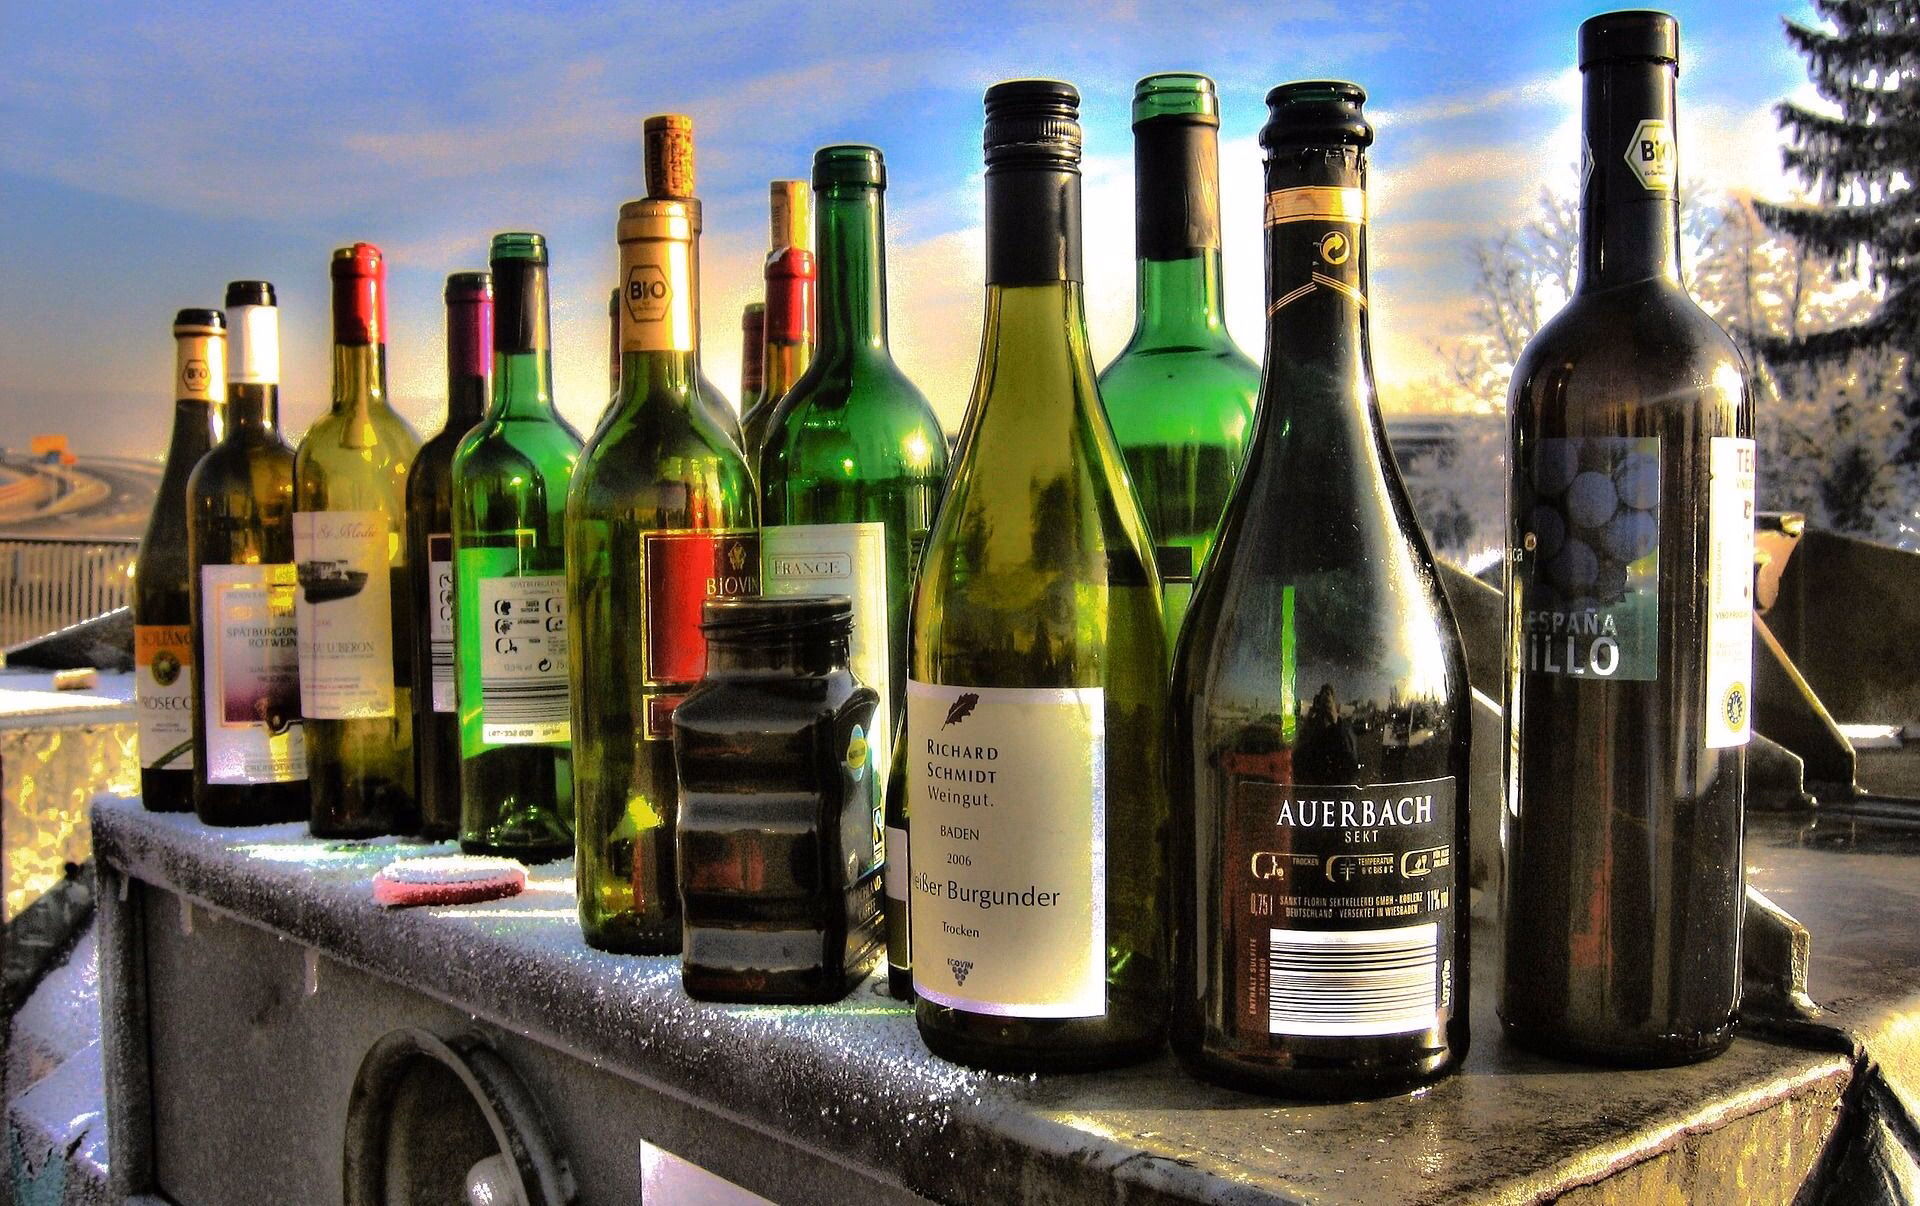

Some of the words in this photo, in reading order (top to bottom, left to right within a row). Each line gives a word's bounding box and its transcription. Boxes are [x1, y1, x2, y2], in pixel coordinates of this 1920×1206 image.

[774, 559, 841, 576] FRANCE
[706, 576, 760, 595] BIOVIN
[1528, 608, 1617, 636] ESPAÑA
[927, 738, 998, 760] RICHARD
[927, 761, 997, 784] SCHMIDT
[927, 785, 994, 809] Weingut.
[1276, 795, 1432, 828] AUERBACH
[940, 824, 980, 841] BADEN
[1345, 830, 1379, 843] SEKT
[947, 853, 972, 867] 2006
[914, 871, 942, 897] eißer
[947, 878, 1061, 910] Burgunder
[1279, 895, 1302, 906] SANKT
[1329, 896, 1374, 907] SEKTKELLEREI
[1285, 907, 1333, 919] DEUTSCHLAND
[1339, 907, 1375, 919] VERSEKTET
[1376, 905, 1384, 917] IN
[942, 920, 980, 939] Trocken
